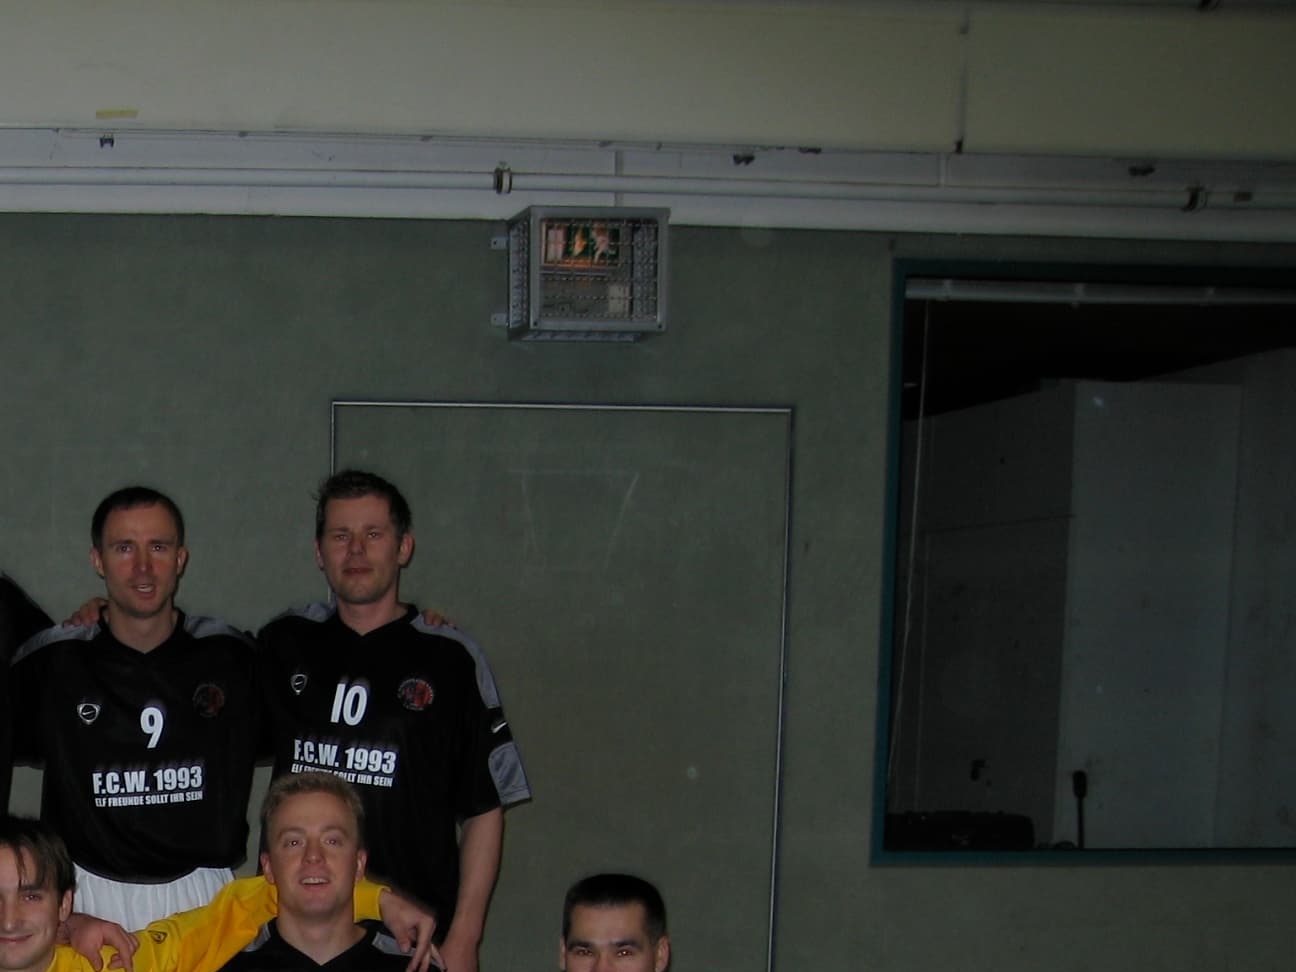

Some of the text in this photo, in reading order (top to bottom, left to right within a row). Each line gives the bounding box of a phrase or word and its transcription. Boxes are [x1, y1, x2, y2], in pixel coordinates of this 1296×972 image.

[330, 683, 368, 726] 10
[140, 707, 164, 749] 9
[294, 739, 396, 774] F.C.W. 1993
[92, 766, 202, 794] F.C.W. 1993
[373, 776, 393, 788] SEIN
[95, 797, 107, 807] ELF
[108, 795, 144, 807] FREUNDE
[145, 794, 169, 805] SOLLT
[185, 790, 203, 801] SEIN
